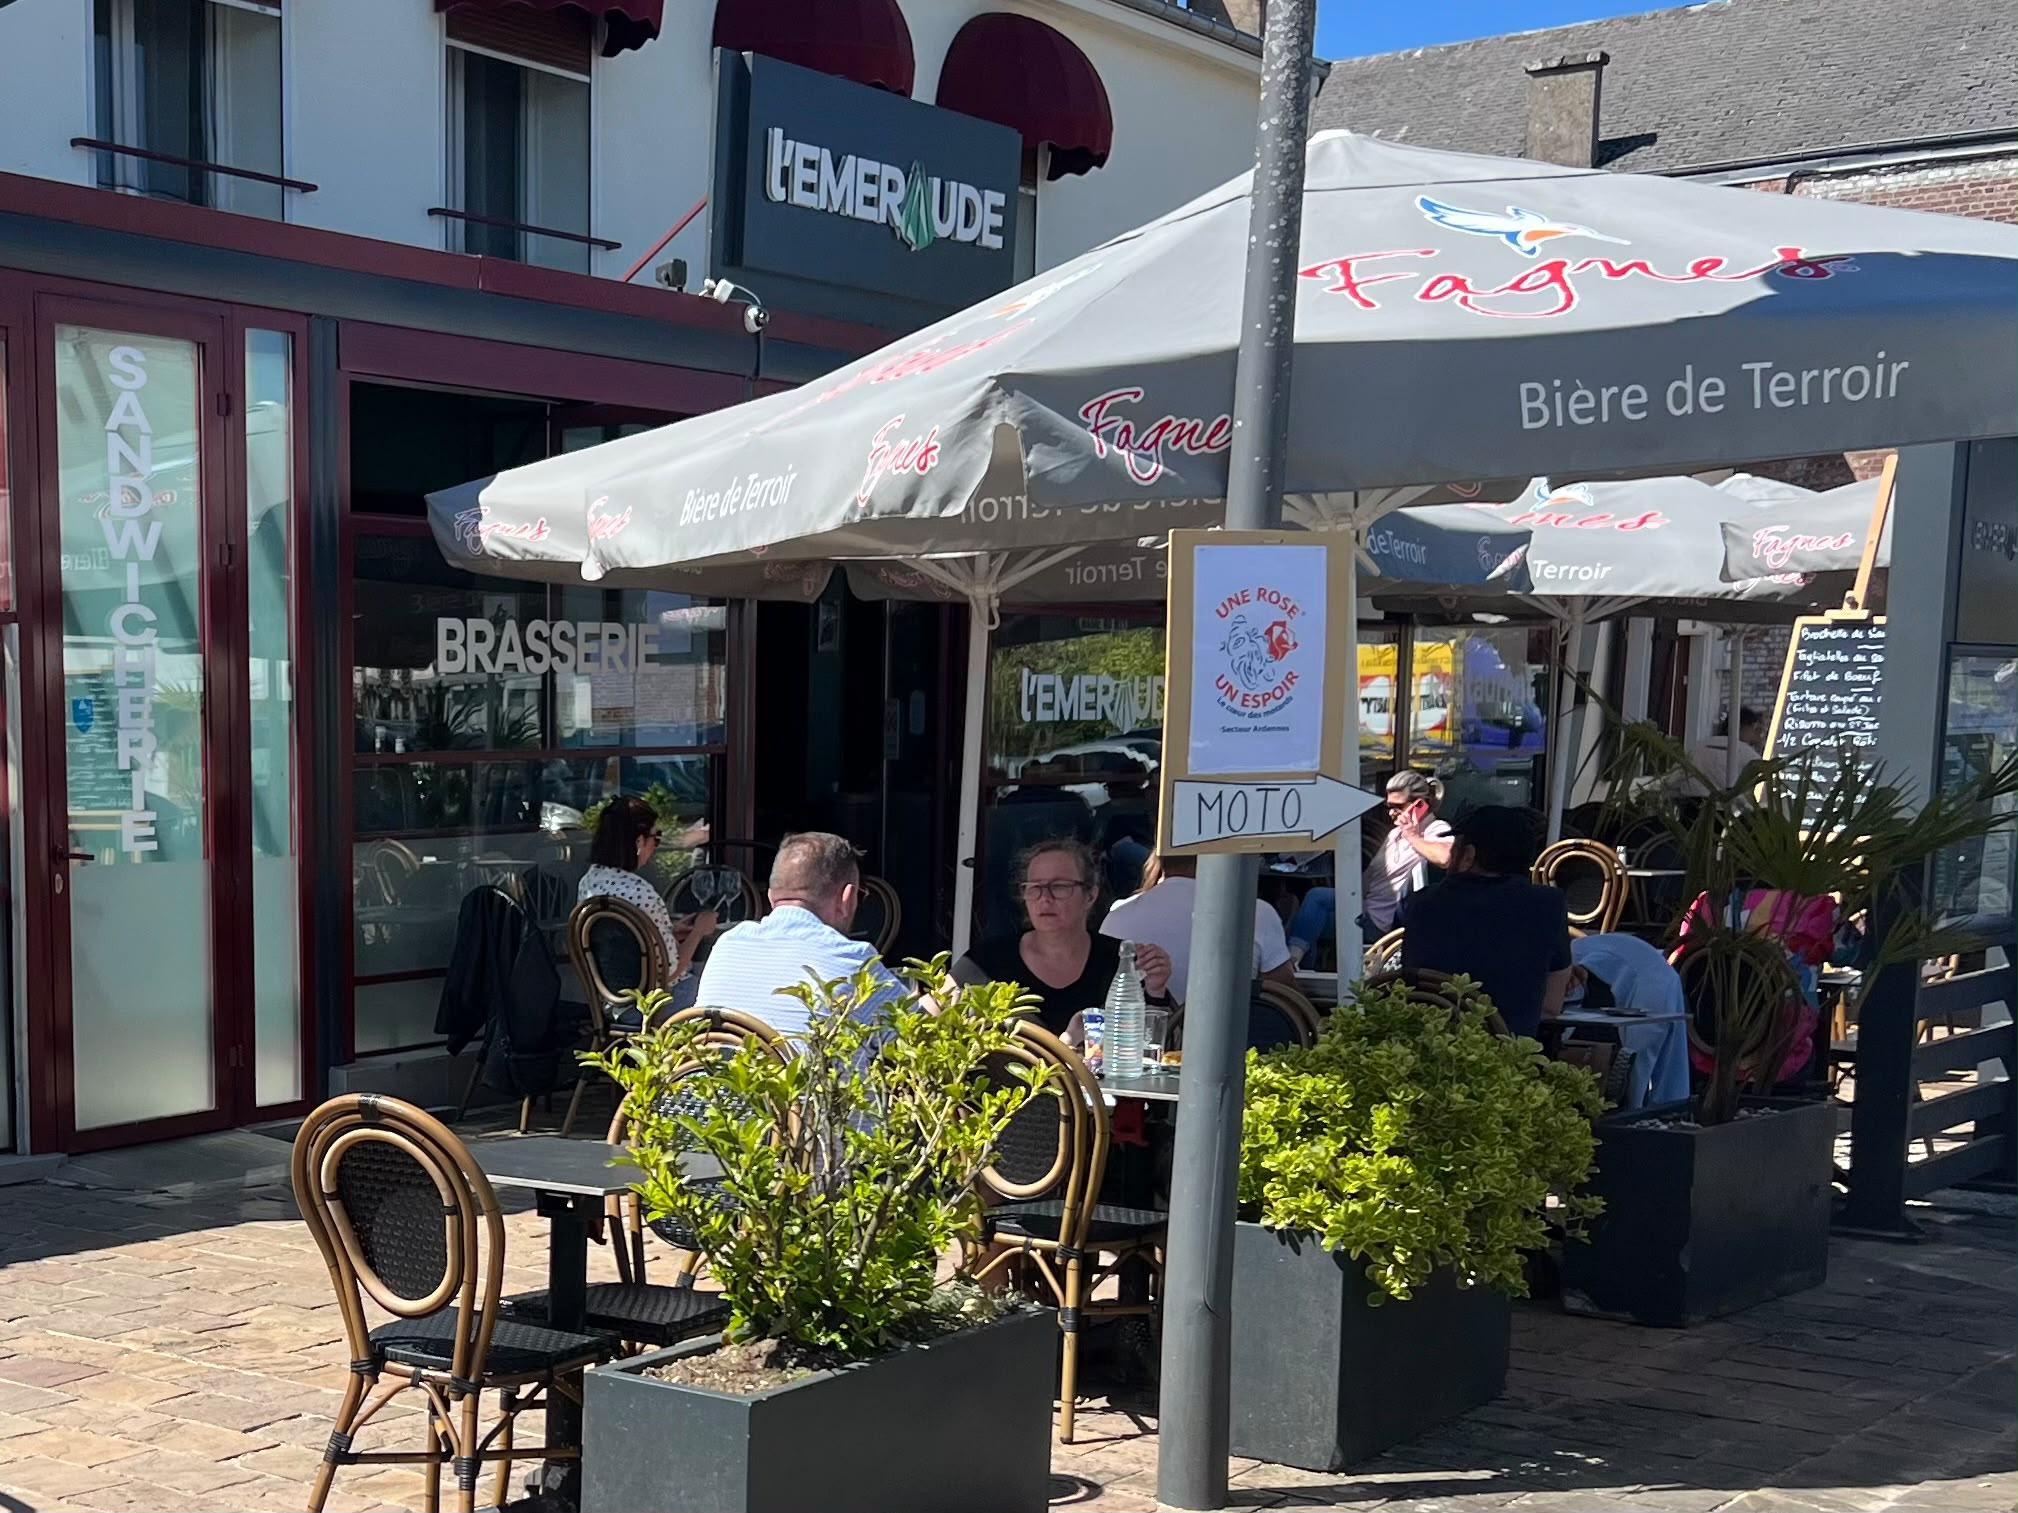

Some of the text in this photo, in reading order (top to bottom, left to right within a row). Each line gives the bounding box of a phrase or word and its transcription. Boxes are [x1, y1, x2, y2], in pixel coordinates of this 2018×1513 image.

[1298, 246, 1853, 318] Fagnes
[1519, 351, 1909, 430] Bière de Terroir
[1079, 387, 1232, 485] Fagne
[680, 464, 798, 526] Bière de Terroir
[1387, 531, 1427, 565] Terroir
[1533, 560, 1612, 581] Terroir
[1752, 525, 1855, 569] Fagnes
[101, 346, 163, 851] SANDWICHERIE
[1215, 587, 1300, 619] UNE ROSE
[437, 617, 661, 674] BRASSERIE
[1215, 671, 1300, 709] UN ESPOIR
[1197, 787, 1302, 836] MOTO
